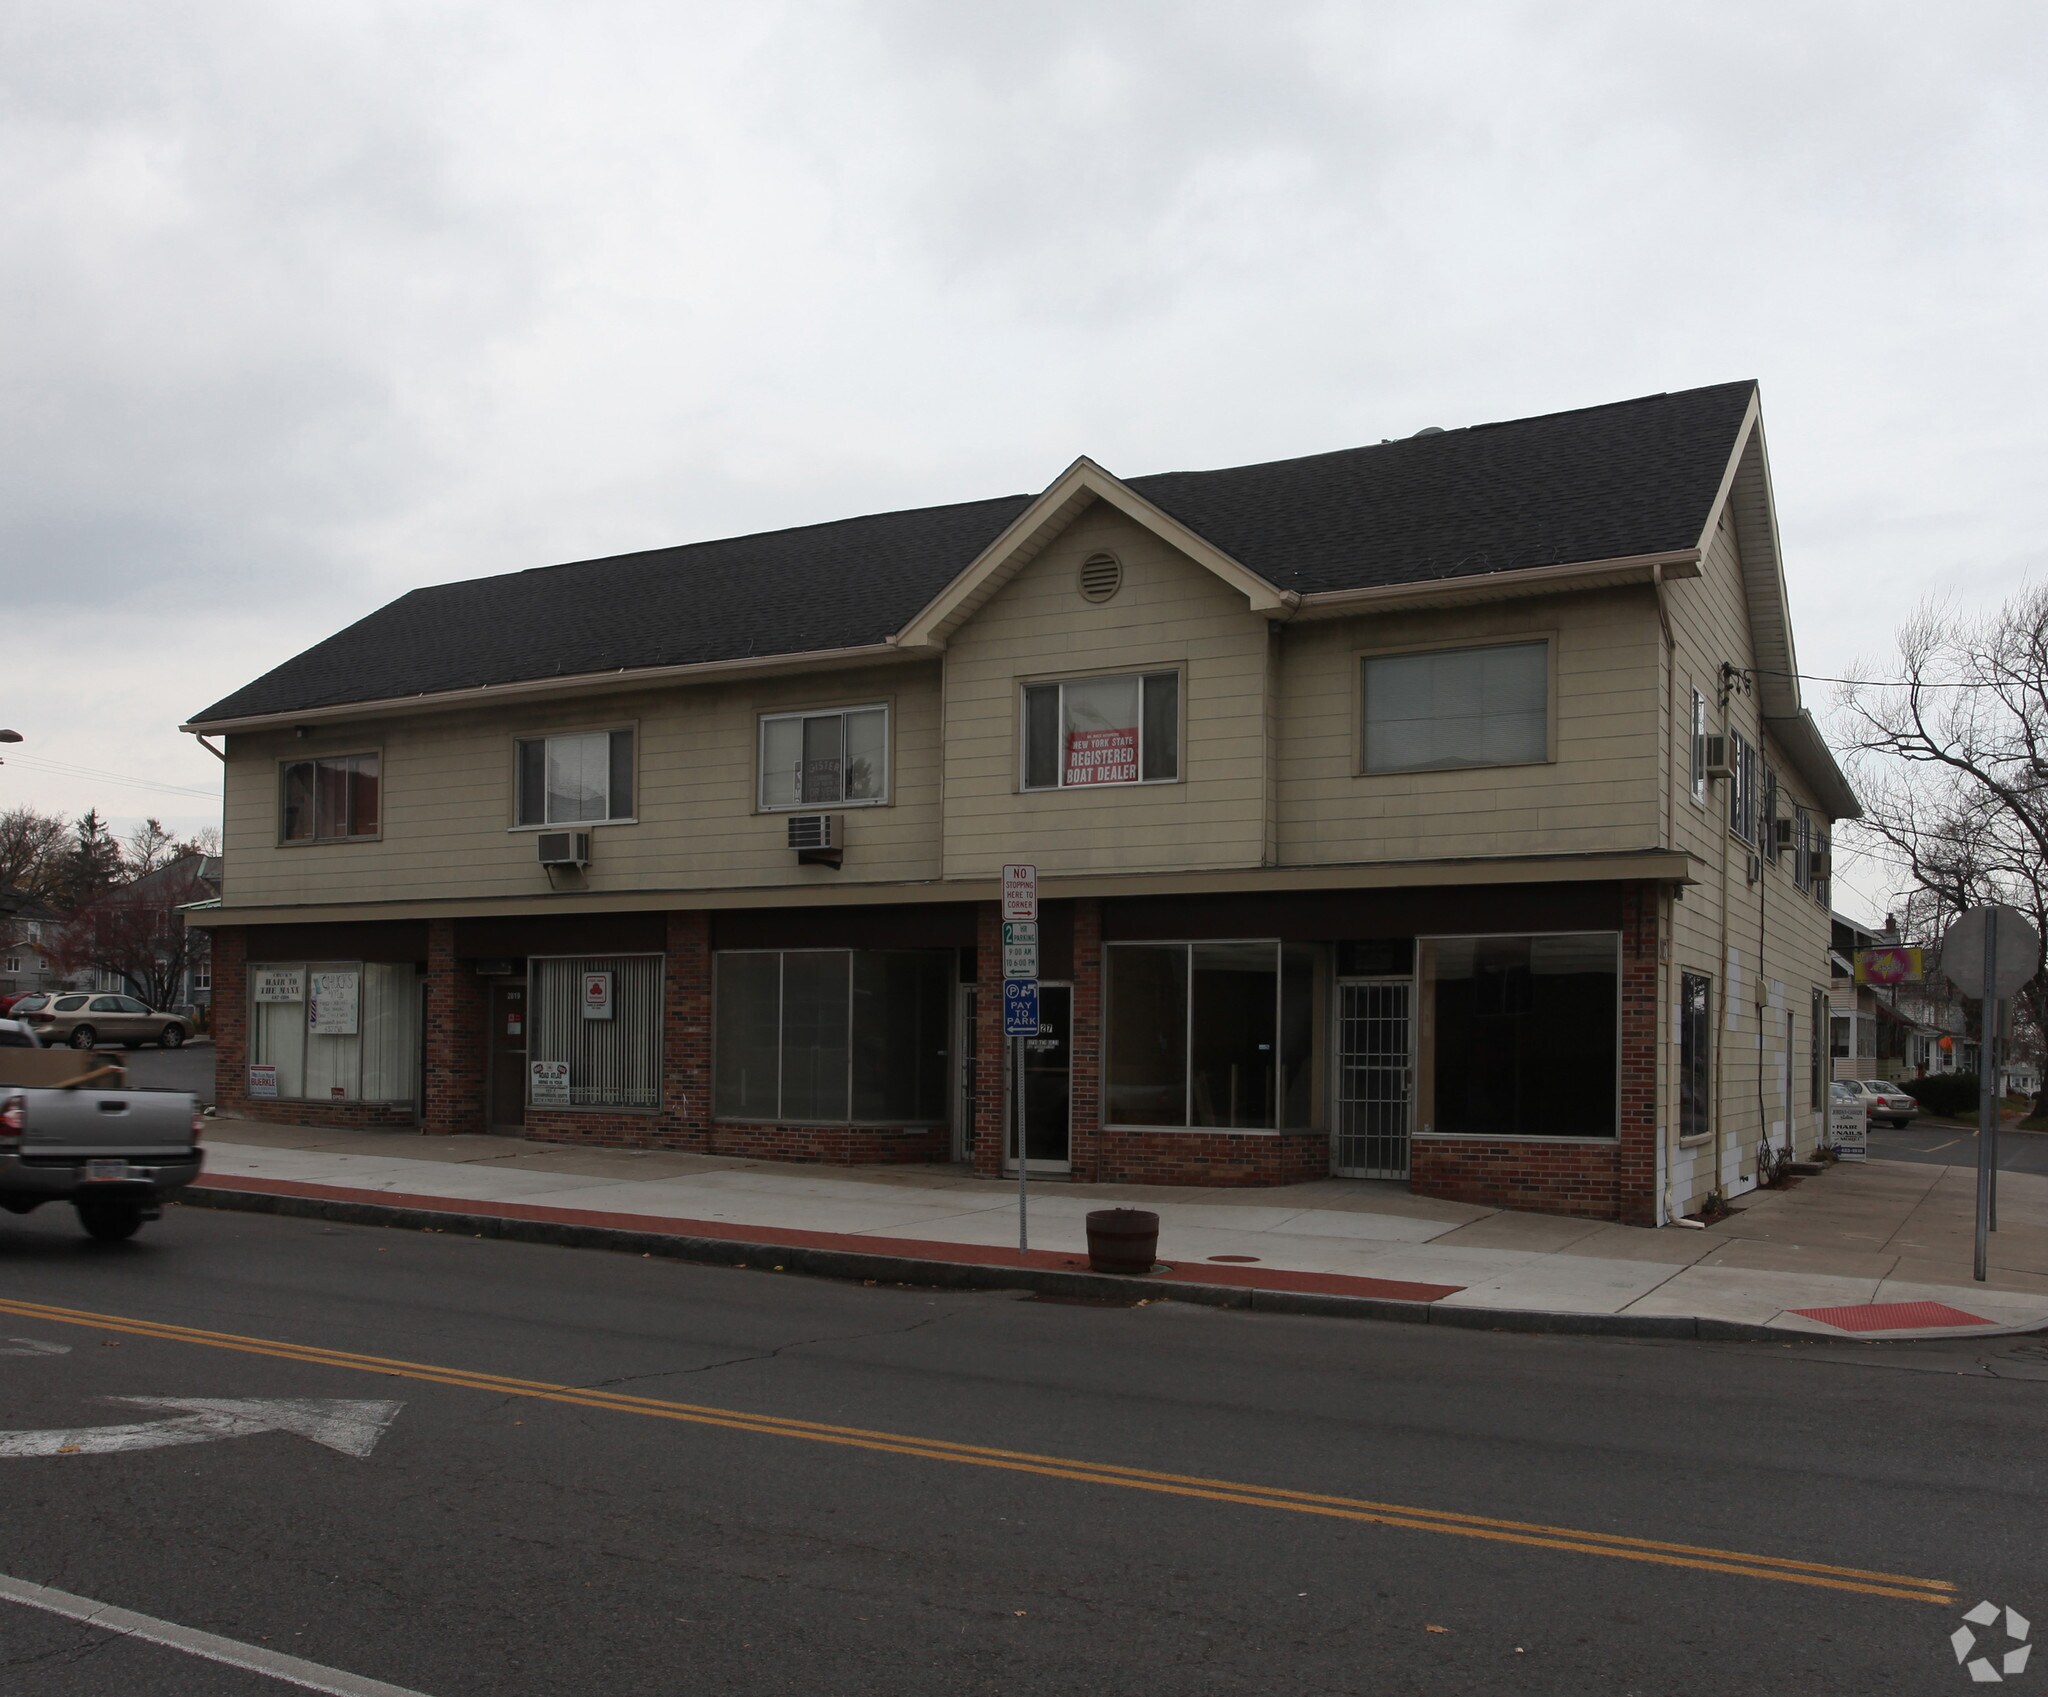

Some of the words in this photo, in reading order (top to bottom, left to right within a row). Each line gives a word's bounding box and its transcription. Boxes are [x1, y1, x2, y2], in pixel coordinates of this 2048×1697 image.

[1073, 740, 1088, 749] NEW
[1091, 739, 1109, 748] YORK
[1112, 737, 1133, 746] STATE
[1072, 748, 1133, 766] REGISTERED
[1066, 768, 1093, 783] BOAT
[1098, 764, 1136, 781] DEALER
[1013, 868, 1026, 878] NO
[1005, 925, 1012, 943] 2
[1014, 934, 1035, 942] PARKING
[1006, 959, 1013, 967] TO
[1015, 1010, 1028, 1018] TO
